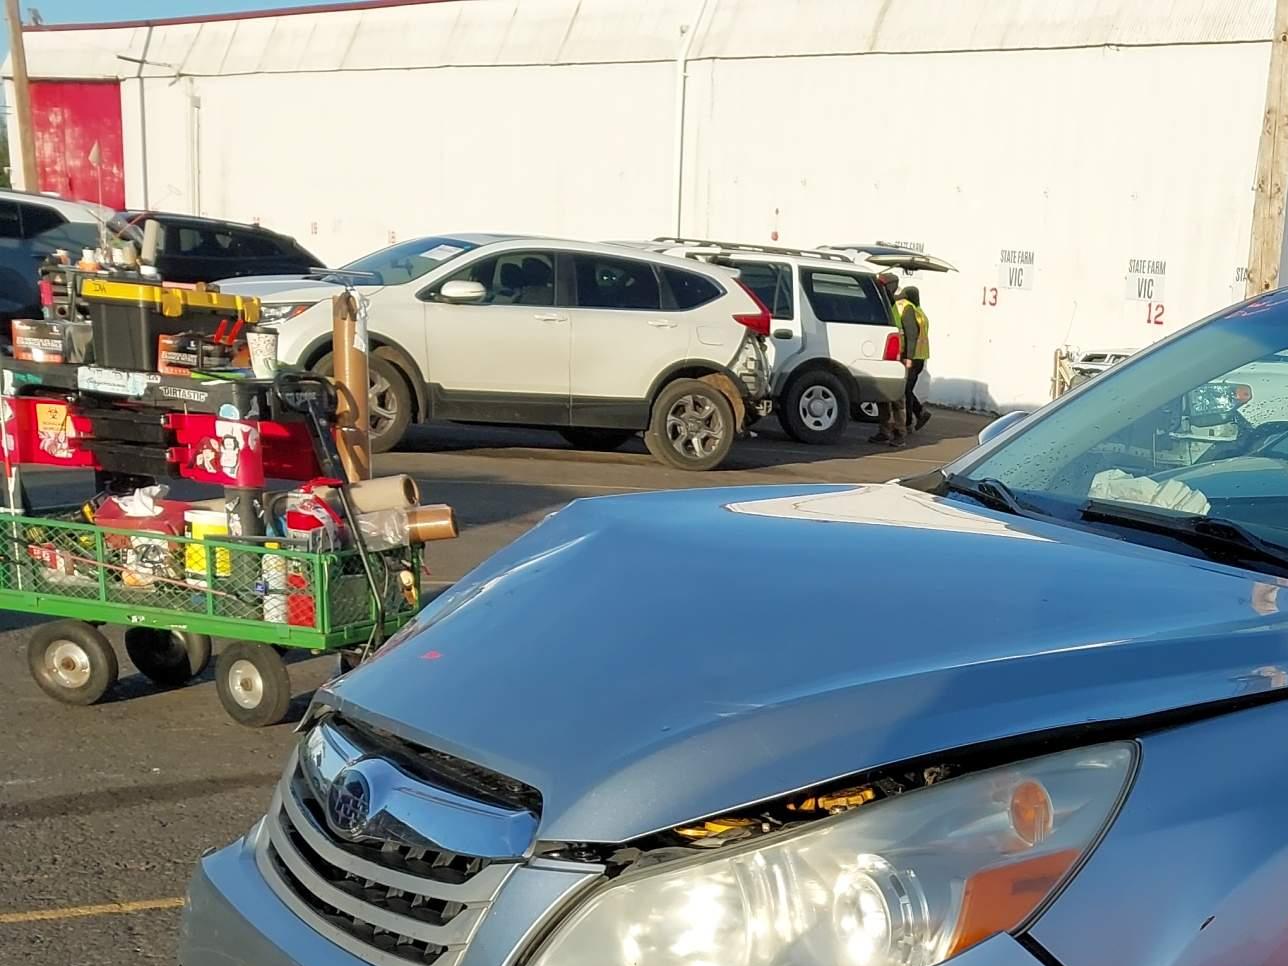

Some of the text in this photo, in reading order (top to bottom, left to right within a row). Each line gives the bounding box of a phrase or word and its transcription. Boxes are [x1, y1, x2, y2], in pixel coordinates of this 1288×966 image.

[1000, 249, 1034, 265] STATE FARM
[1128, 259, 1166, 275] STATE FARM
[1009, 267, 1024, 287] VIC
[1235, 267, 1248, 282] STA
[982, 286, 998, 307] 13
[1137, 277, 1154, 299] VIC
[1146, 302, 1165, 325] 12
